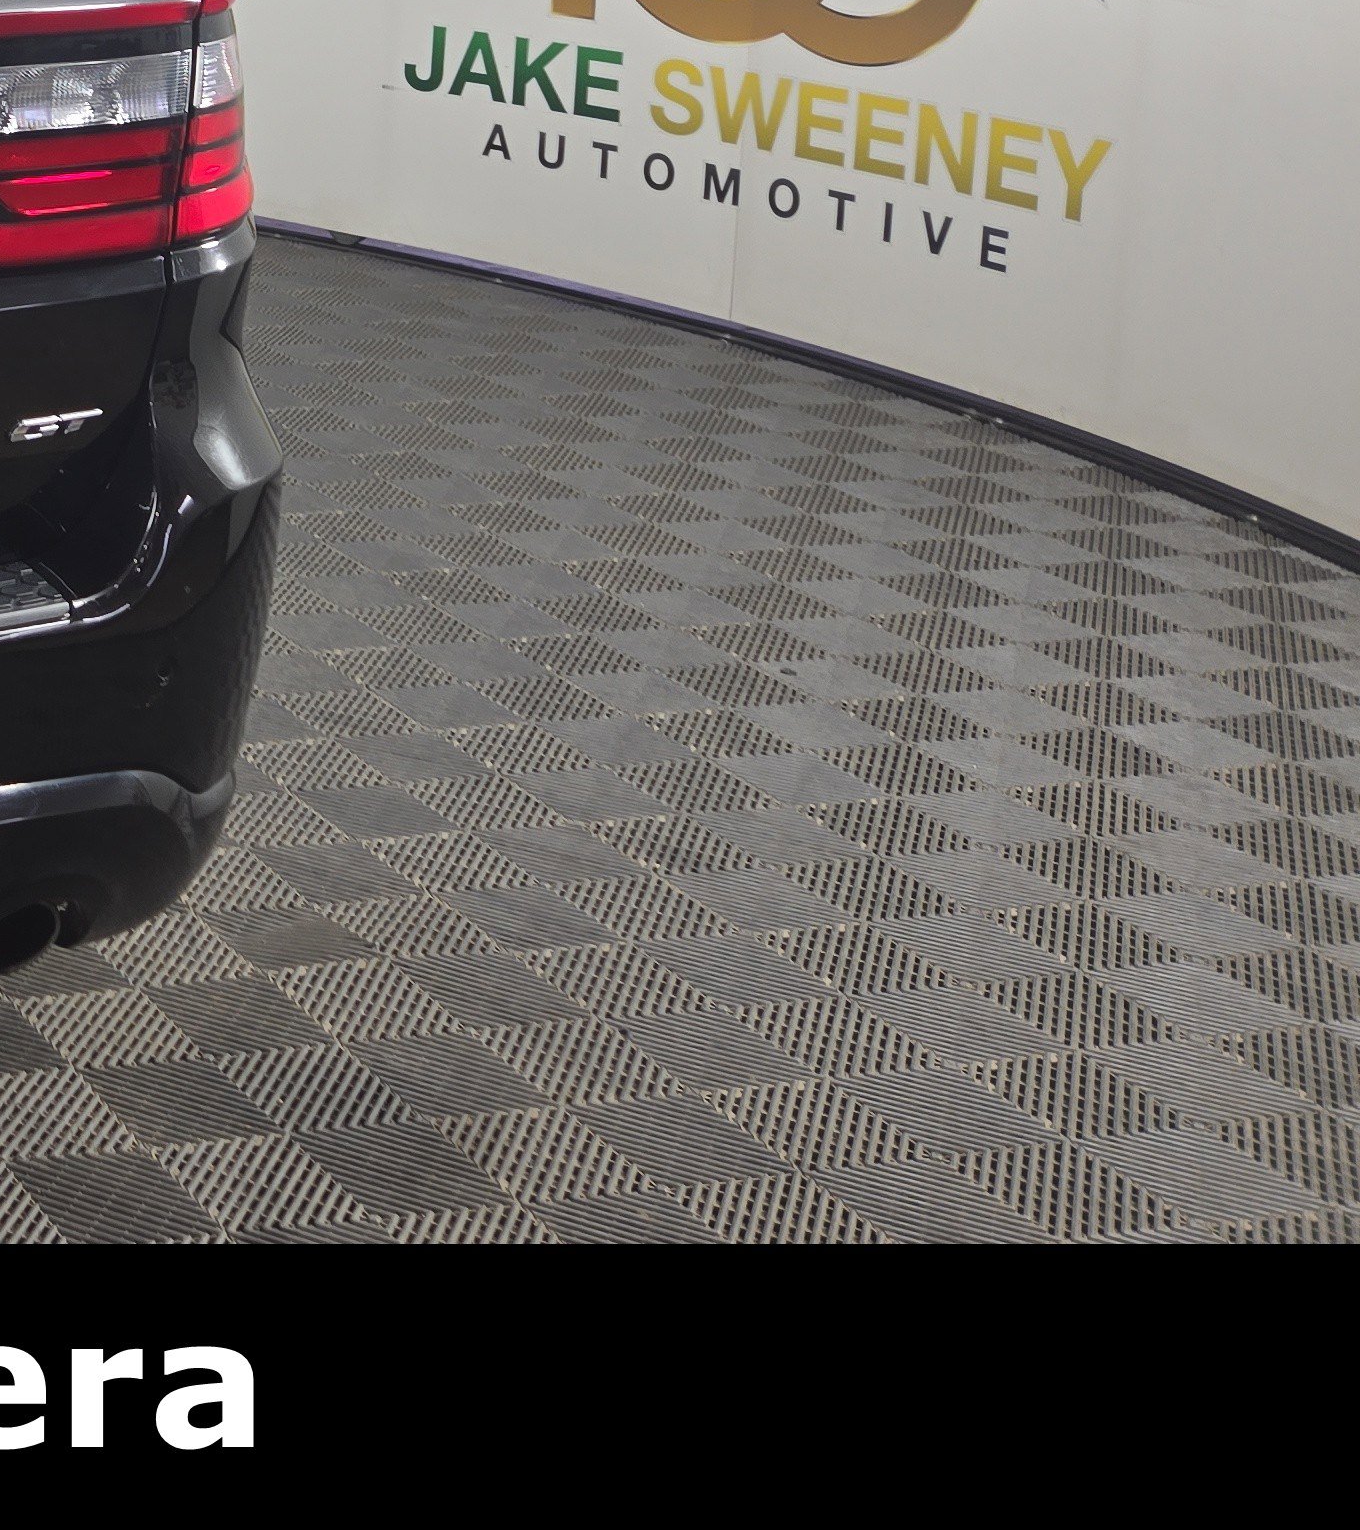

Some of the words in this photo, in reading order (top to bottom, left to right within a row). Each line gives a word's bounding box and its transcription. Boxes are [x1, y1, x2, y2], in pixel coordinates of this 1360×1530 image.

[404, 25, 623, 123] JAKE
[650, 58, 1111, 222] SWEENEY
[482, 124, 1011, 273] AUTOMOTIVE
[10, 407, 104, 442] GT
